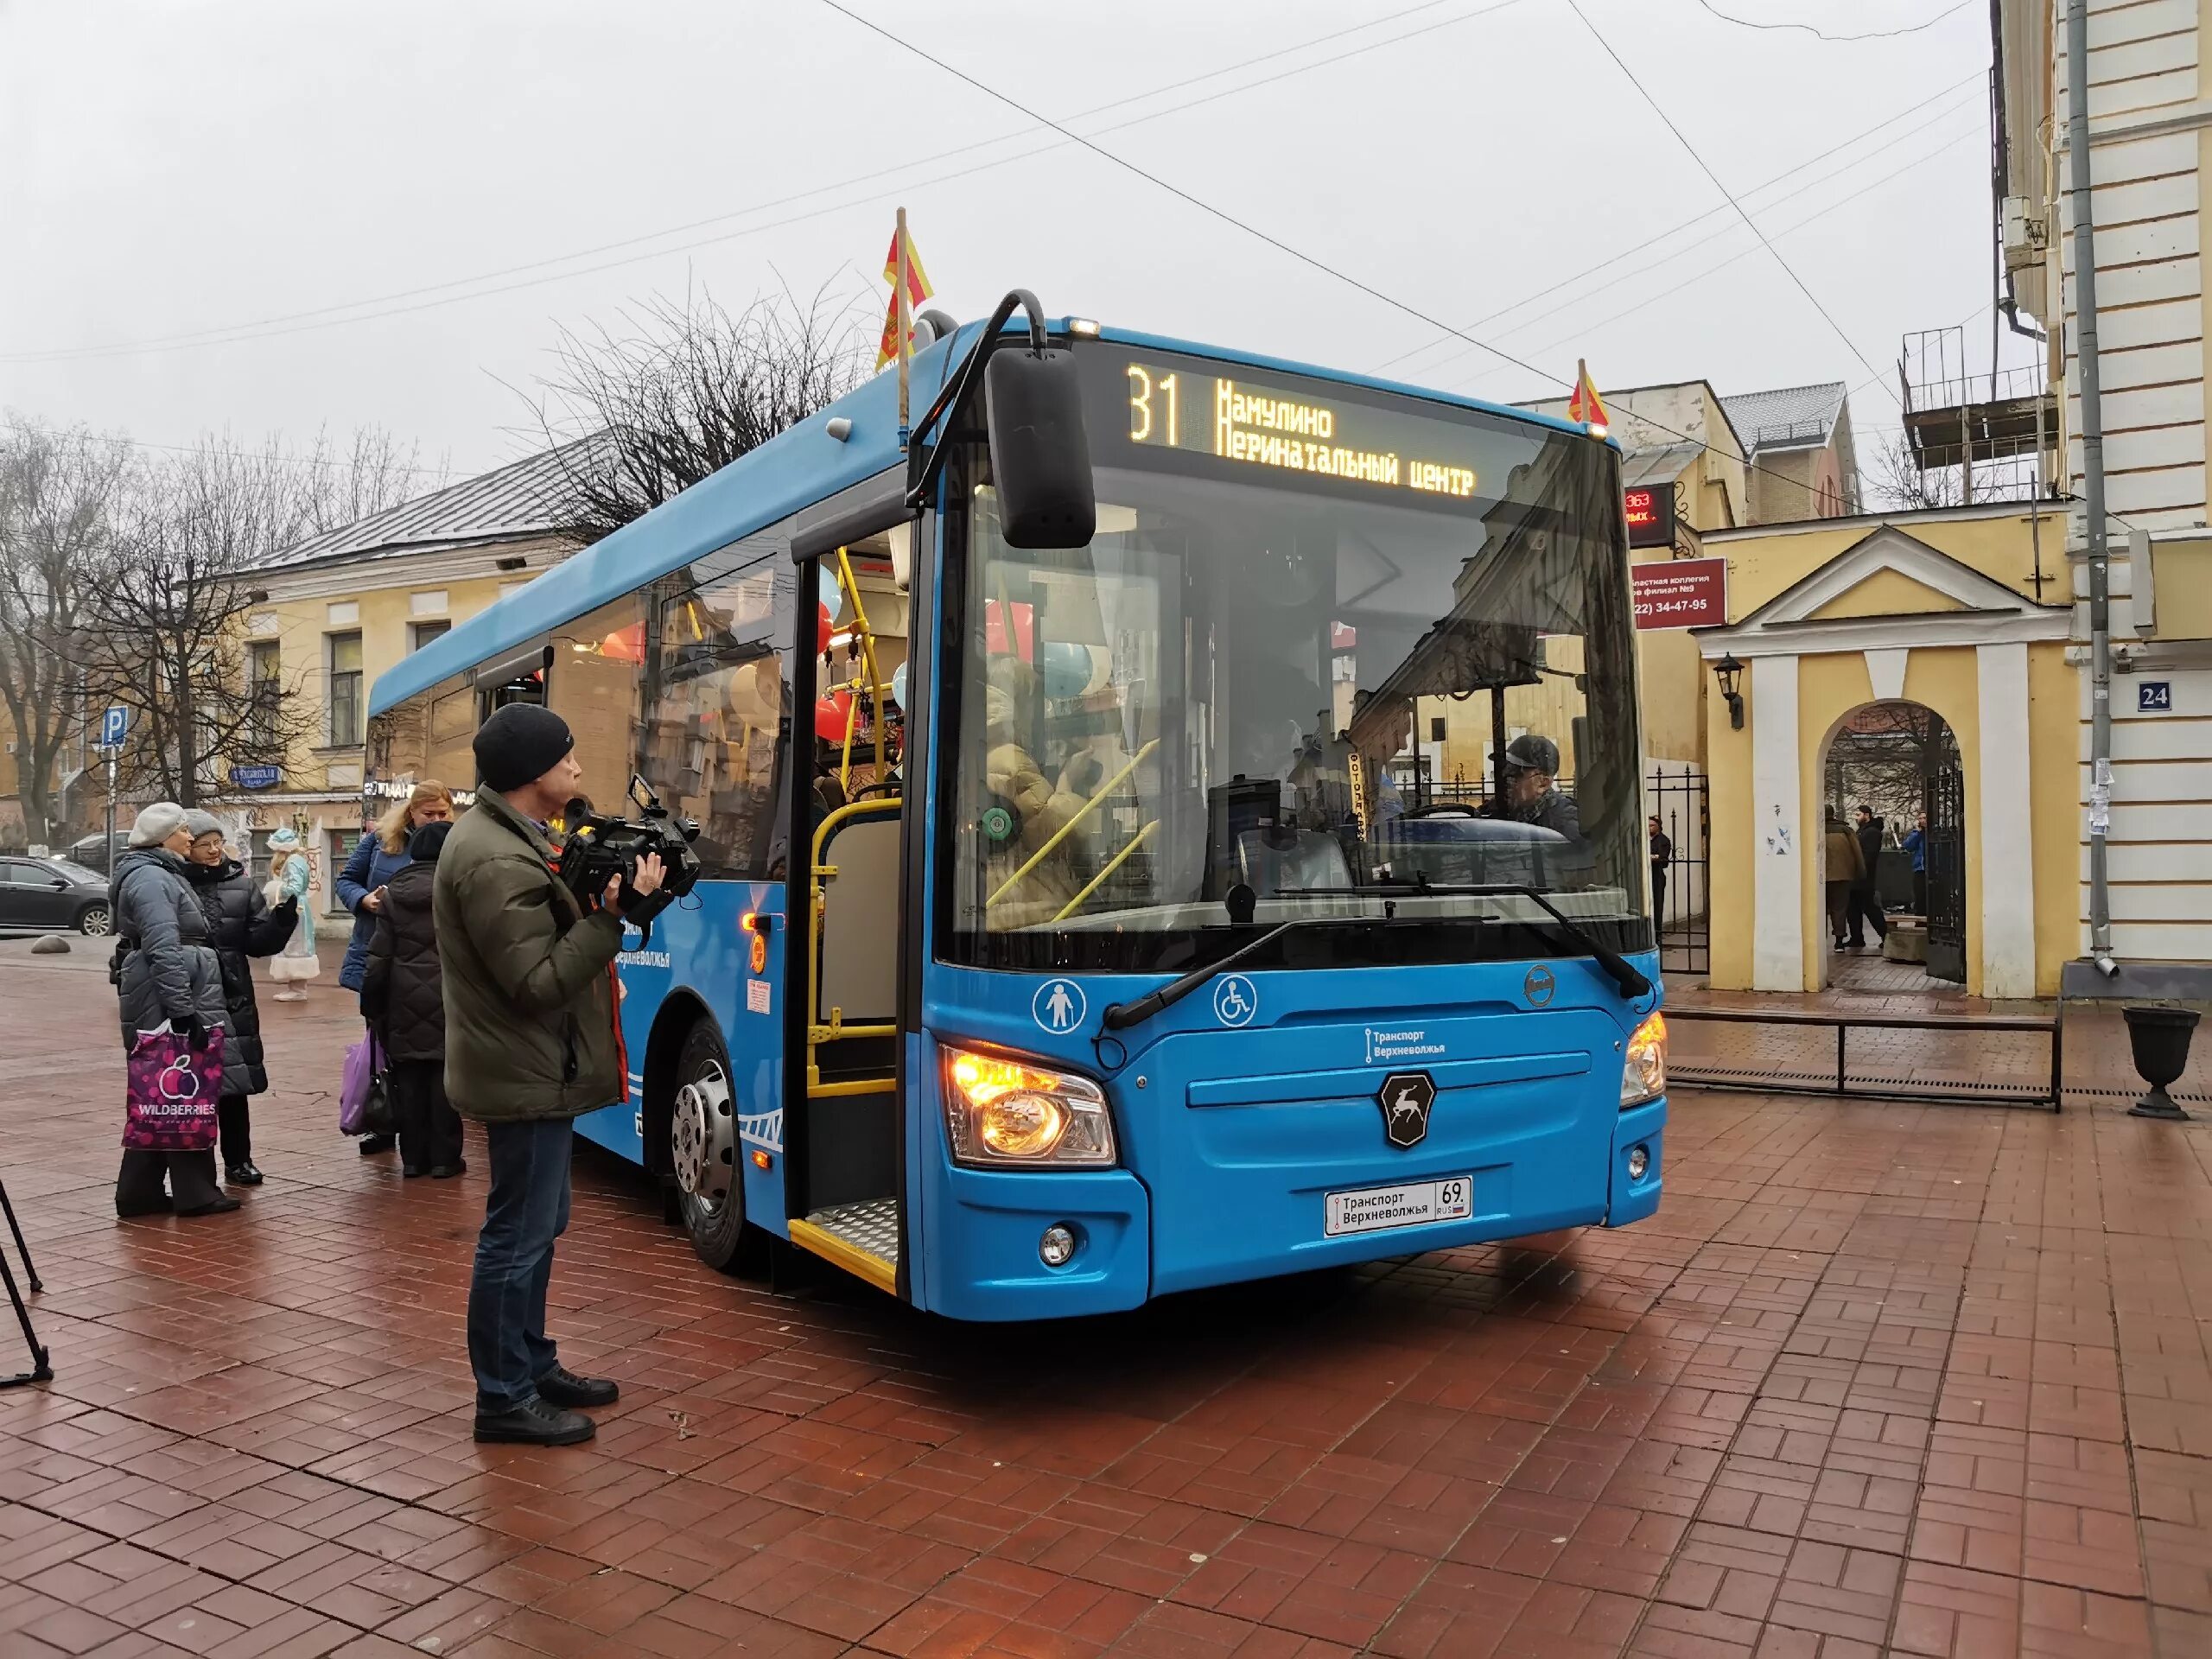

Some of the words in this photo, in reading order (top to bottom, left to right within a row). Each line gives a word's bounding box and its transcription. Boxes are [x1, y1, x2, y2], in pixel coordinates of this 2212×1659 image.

[1127, 363, 1179, 447] 31
[1410, 460, 1474, 496] центр
[1669, 575, 1710, 585] коллегия
[1643, 586, 1678, 597] филиал
[1656, 599, 1707, 613] 34-47-95
[2143, 687, 2168, 705] 24
[1373, 1031, 1425, 1046] Транспорт
[1374, 1044, 1446, 1060] Верхневолжья
[138, 1103, 216, 1116] WILDBERRIES
[1442, 1182, 1462, 1205] 69
[1344, 1193, 1405, 1211] Транспорт
[1436, 1205, 1452, 1215] RUS
[1344, 1205, 1428, 1225] Верхневолжья
